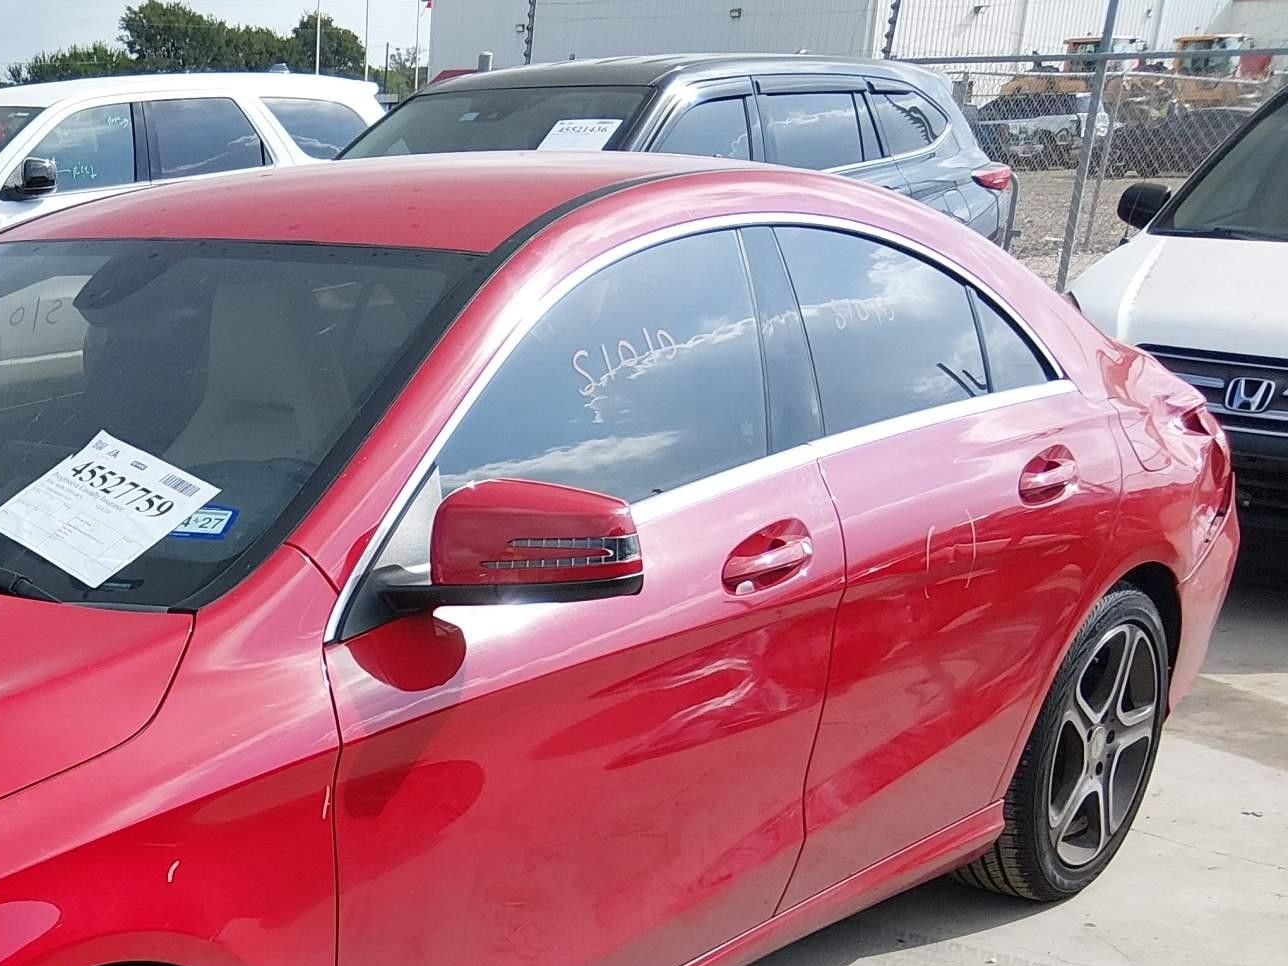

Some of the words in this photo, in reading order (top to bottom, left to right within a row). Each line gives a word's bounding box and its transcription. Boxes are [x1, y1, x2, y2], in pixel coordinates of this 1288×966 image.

[556, 125, 609, 134] 45521436
[71, 460, 175, 518] 45527759
[198, 516, 225, 529] 27
